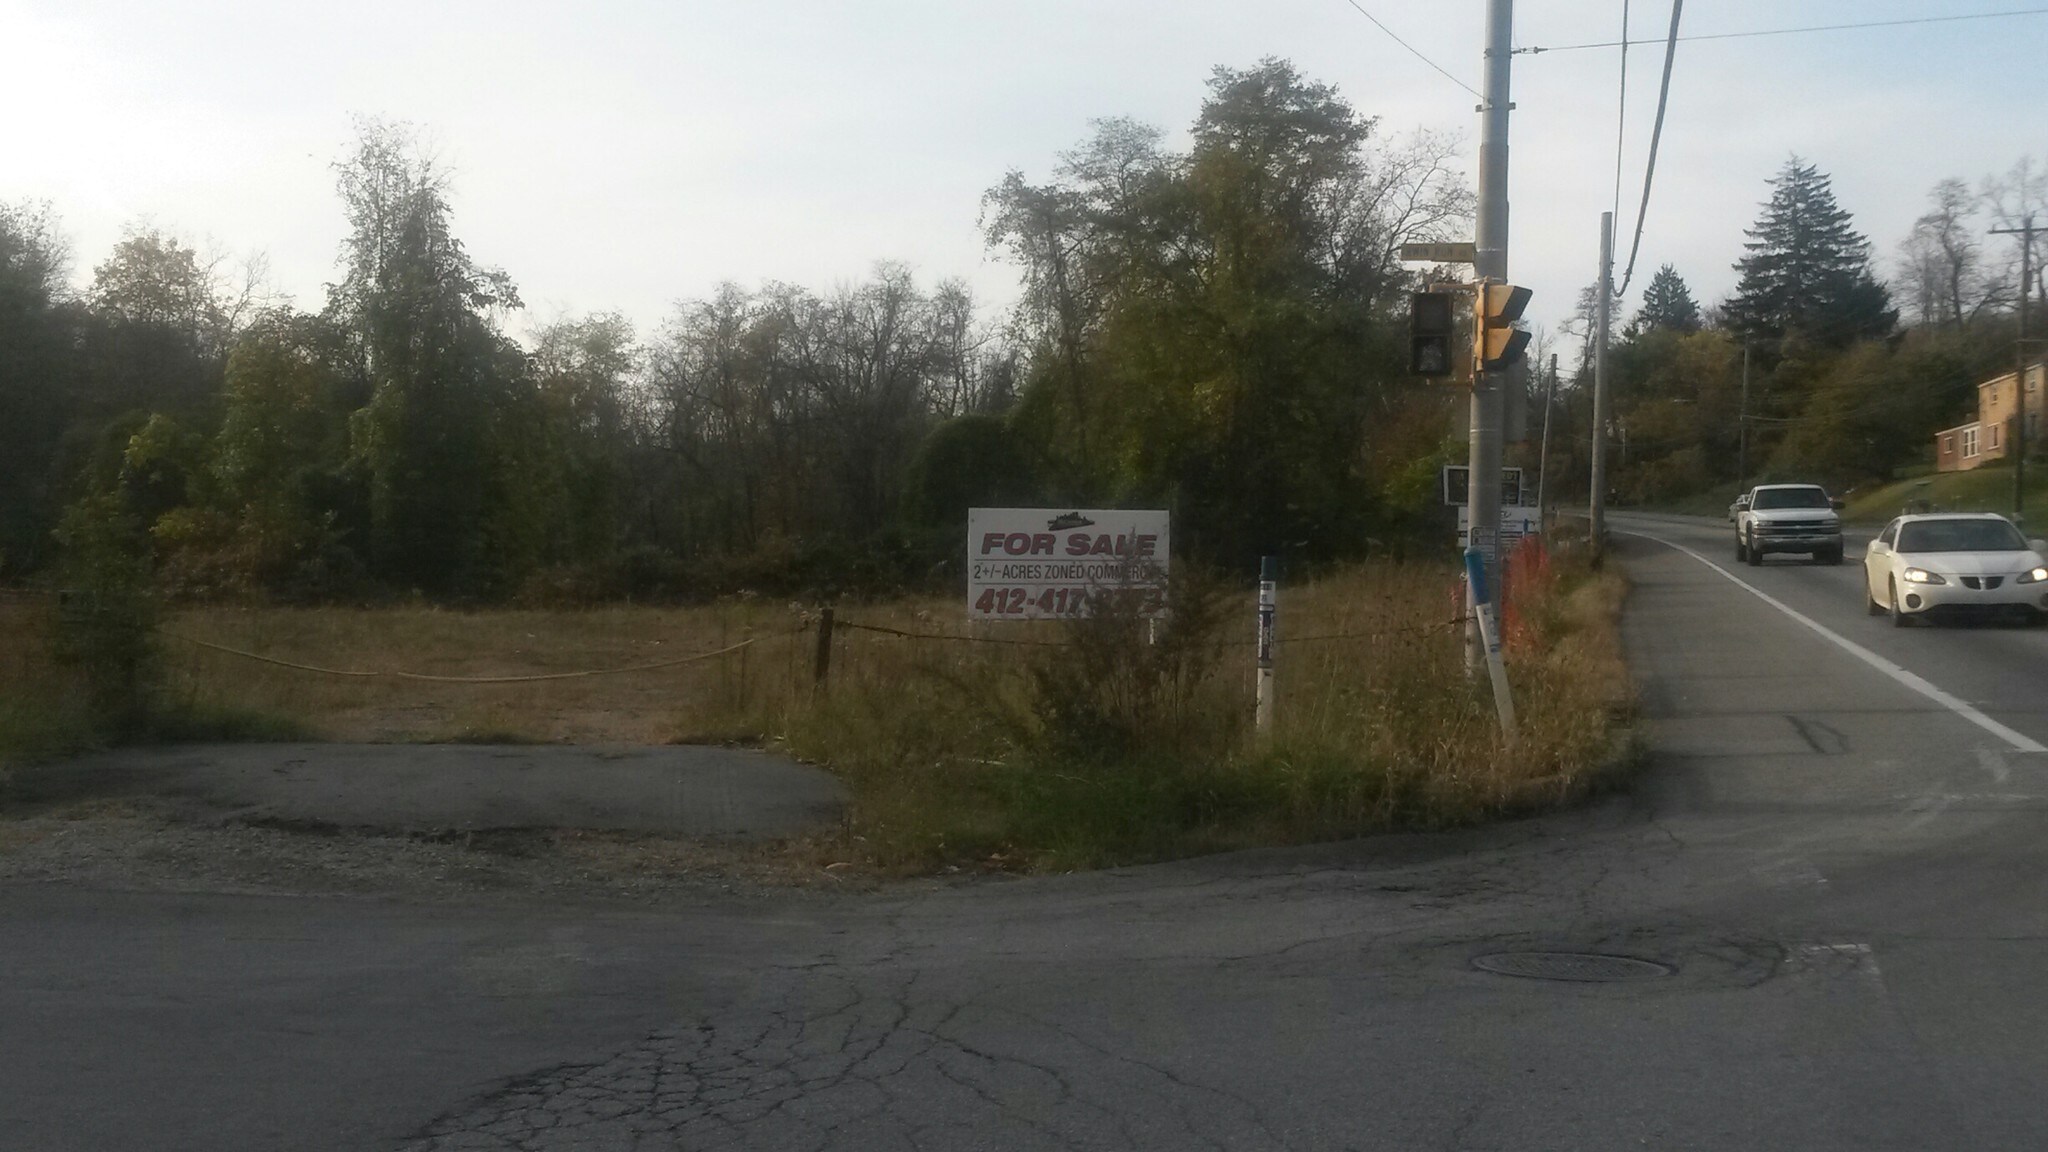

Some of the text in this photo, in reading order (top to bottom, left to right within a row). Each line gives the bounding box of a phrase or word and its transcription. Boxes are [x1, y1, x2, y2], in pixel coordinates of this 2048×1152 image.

[981, 533, 1158, 556] FOR SALE
[1044, 564, 1084, 579] ZONED
[1087, 565, 1162, 580] COMMRC
[975, 588, 1162, 615] 412-417
